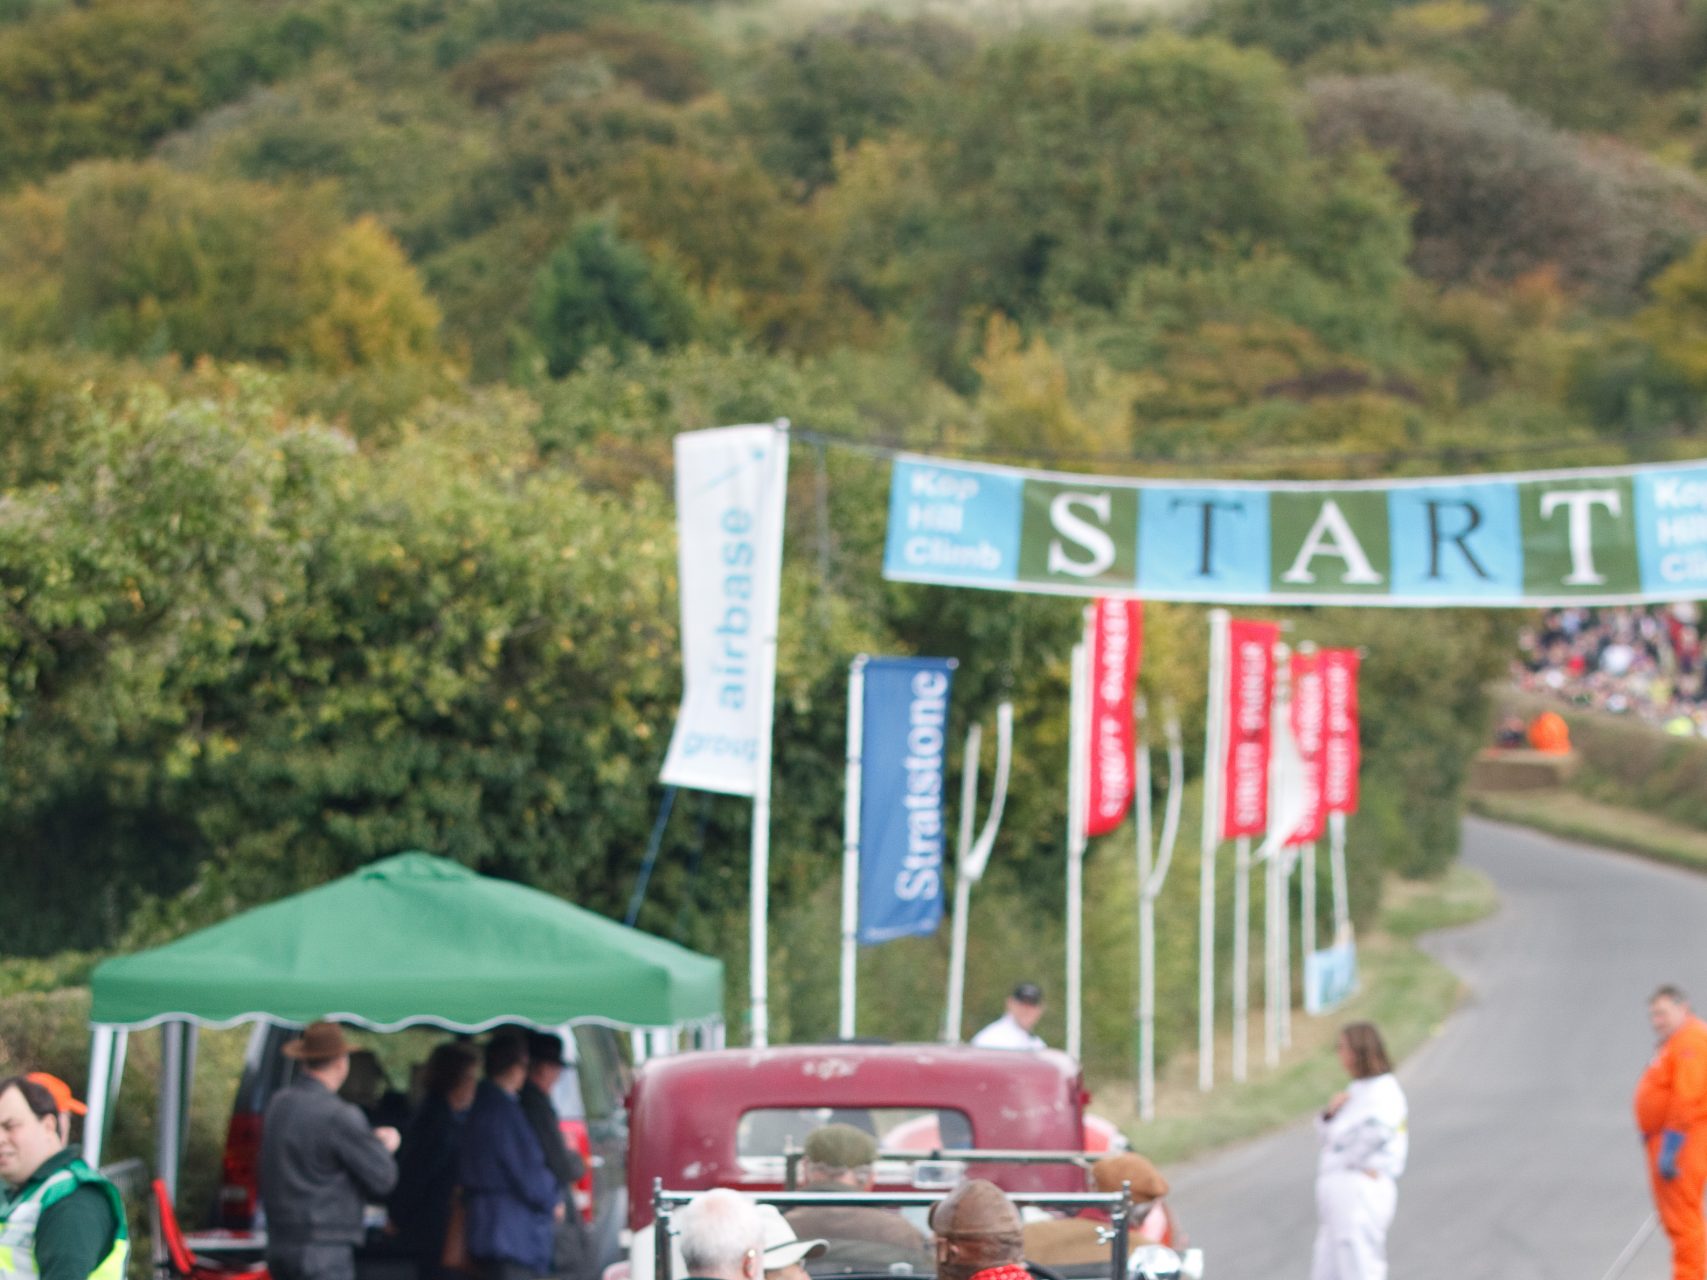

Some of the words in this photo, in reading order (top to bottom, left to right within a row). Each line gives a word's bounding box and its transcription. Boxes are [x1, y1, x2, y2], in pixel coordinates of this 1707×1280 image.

[904, 537, 1003, 571] Climb
[907, 503, 964, 532] Hill
[1048, 488, 1622, 586] START
[715, 506, 755, 711] airbase
[894, 670, 949, 901] Stratstone
